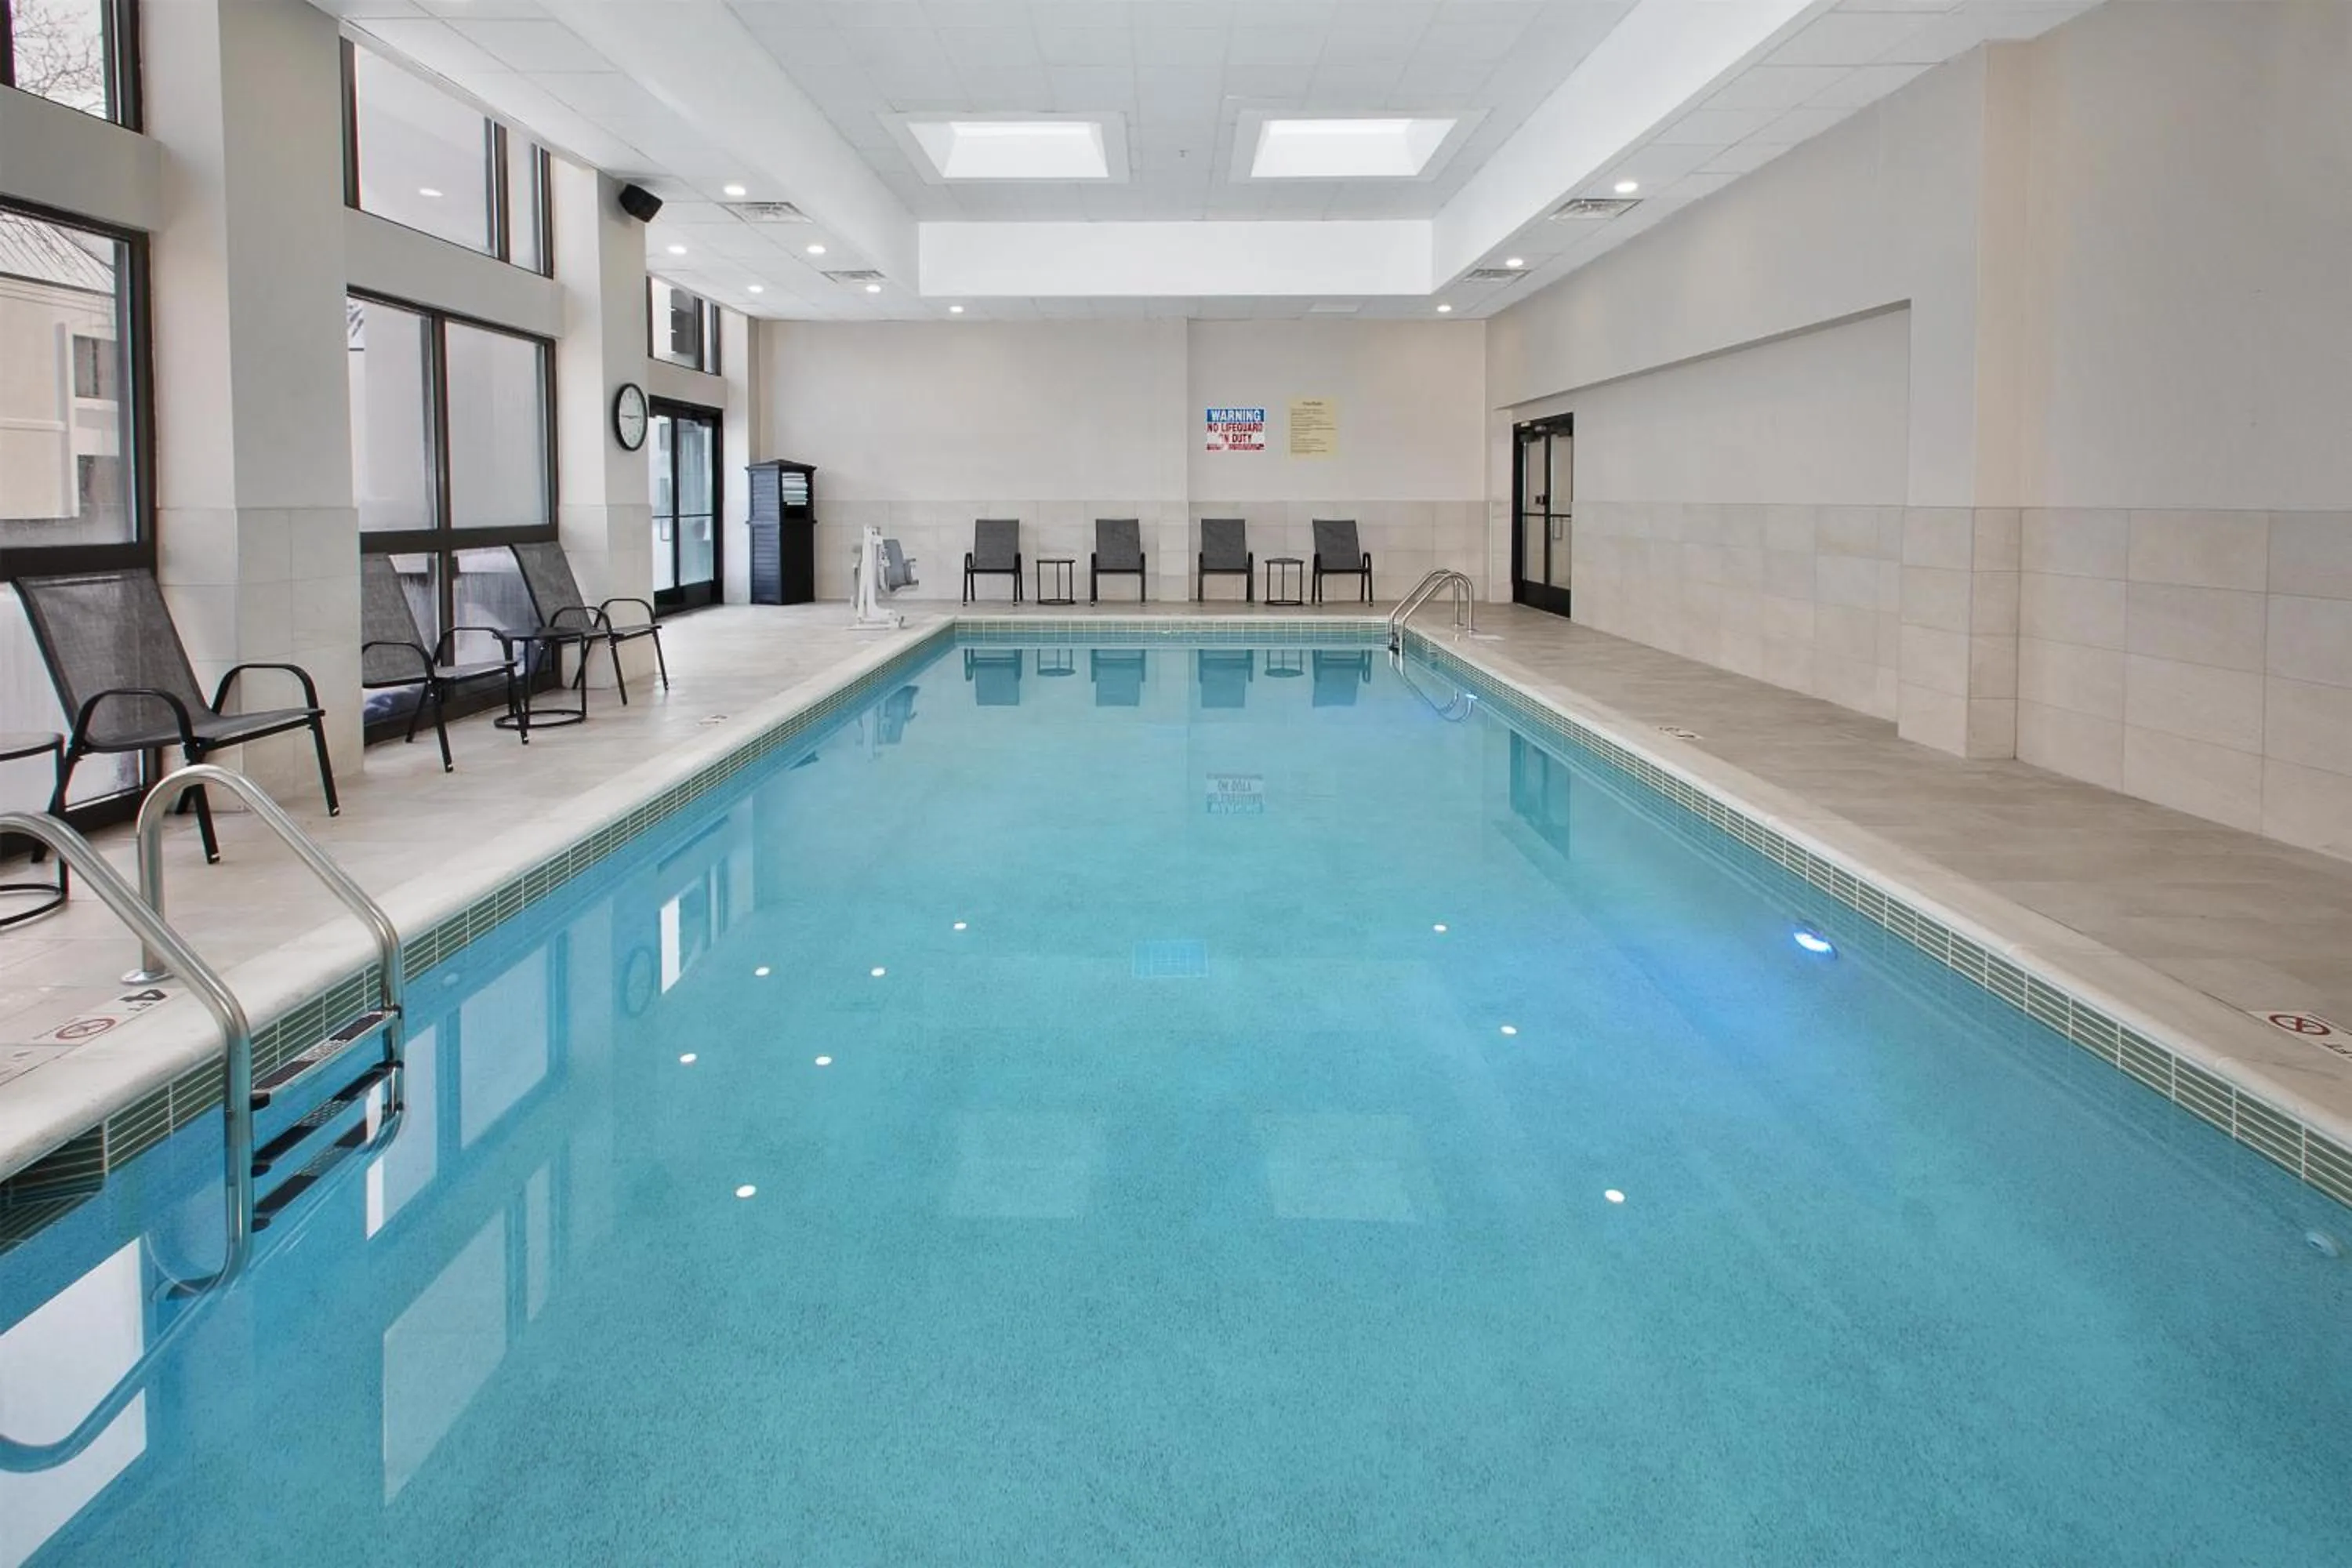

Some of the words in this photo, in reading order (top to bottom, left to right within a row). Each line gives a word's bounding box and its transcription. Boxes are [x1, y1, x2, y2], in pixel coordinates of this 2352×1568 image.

[1211, 410, 1261, 421] WARNING
[1207, 423, 1218, 432] NO
[1221, 423, 1262, 432] LIFEGUARD
[1232, 434, 1251, 443] DUTY
[119, 989, 167, 1002] 4
